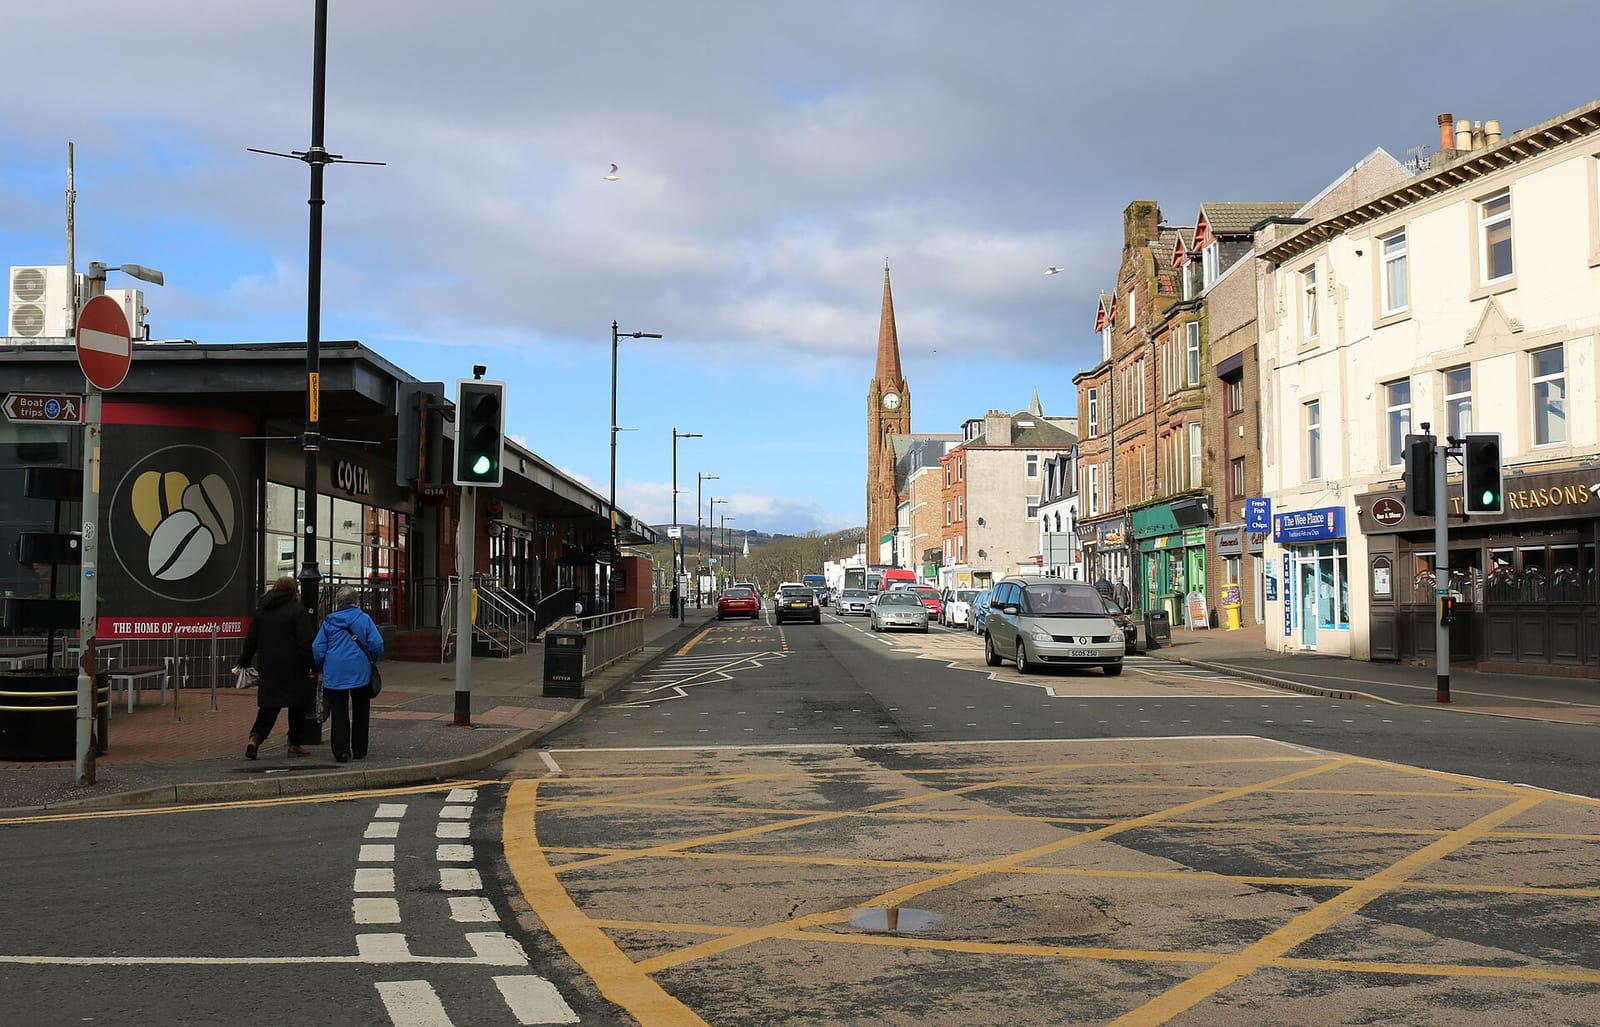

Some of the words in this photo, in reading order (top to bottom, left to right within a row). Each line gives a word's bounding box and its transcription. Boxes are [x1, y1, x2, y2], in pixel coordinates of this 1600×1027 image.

[20, 397, 43, 407] Boat
[21, 408, 43, 418] trips
[337, 459, 370, 496] COSTA
[422, 488, 444, 496] OSTA
[1508, 483, 1590, 511] REASONS
[1251, 499, 1267, 507] Fresh
[1284, 515, 1295, 527] The
[1294, 514, 1307, 526] Wee
[1307, 512, 1325, 525] Plaice
[1251, 521, 1268, 530] Chips
[113, 622, 132, 634] THE
[134, 622, 160, 634] HOME
[162, 622, 173, 634] OF
[222, 621, 242, 633] COFFEE
